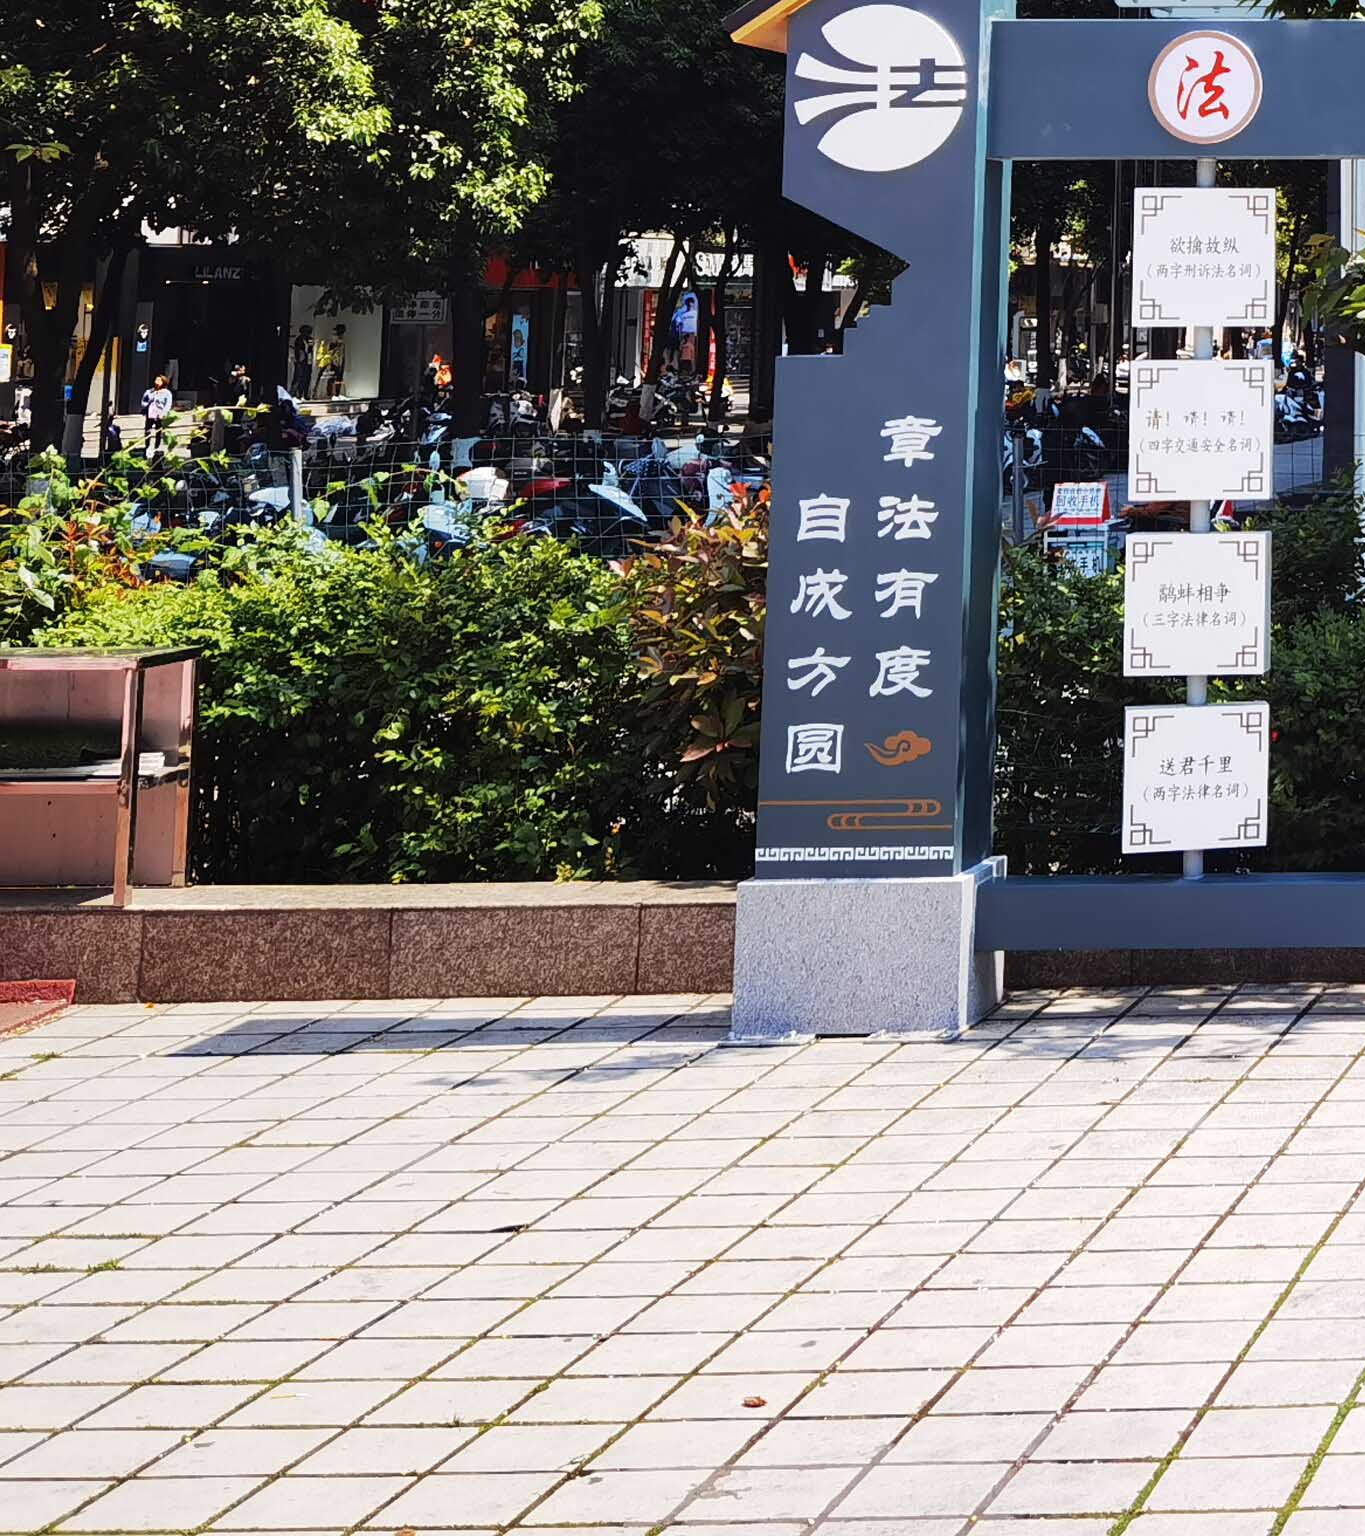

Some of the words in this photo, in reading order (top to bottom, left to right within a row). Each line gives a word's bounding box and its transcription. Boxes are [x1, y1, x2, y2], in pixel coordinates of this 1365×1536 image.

[1170, 236, 1239, 255] 欲擒故纵
[868, 414, 943, 699] 章法有度
[1142, 612, 1248, 628] （三字法律名词）
[785, 492, 854, 775] 自成方圆
[1159, 755, 1233, 776] 送君千里
[1142, 784, 1249, 801] （两字法律名词）
